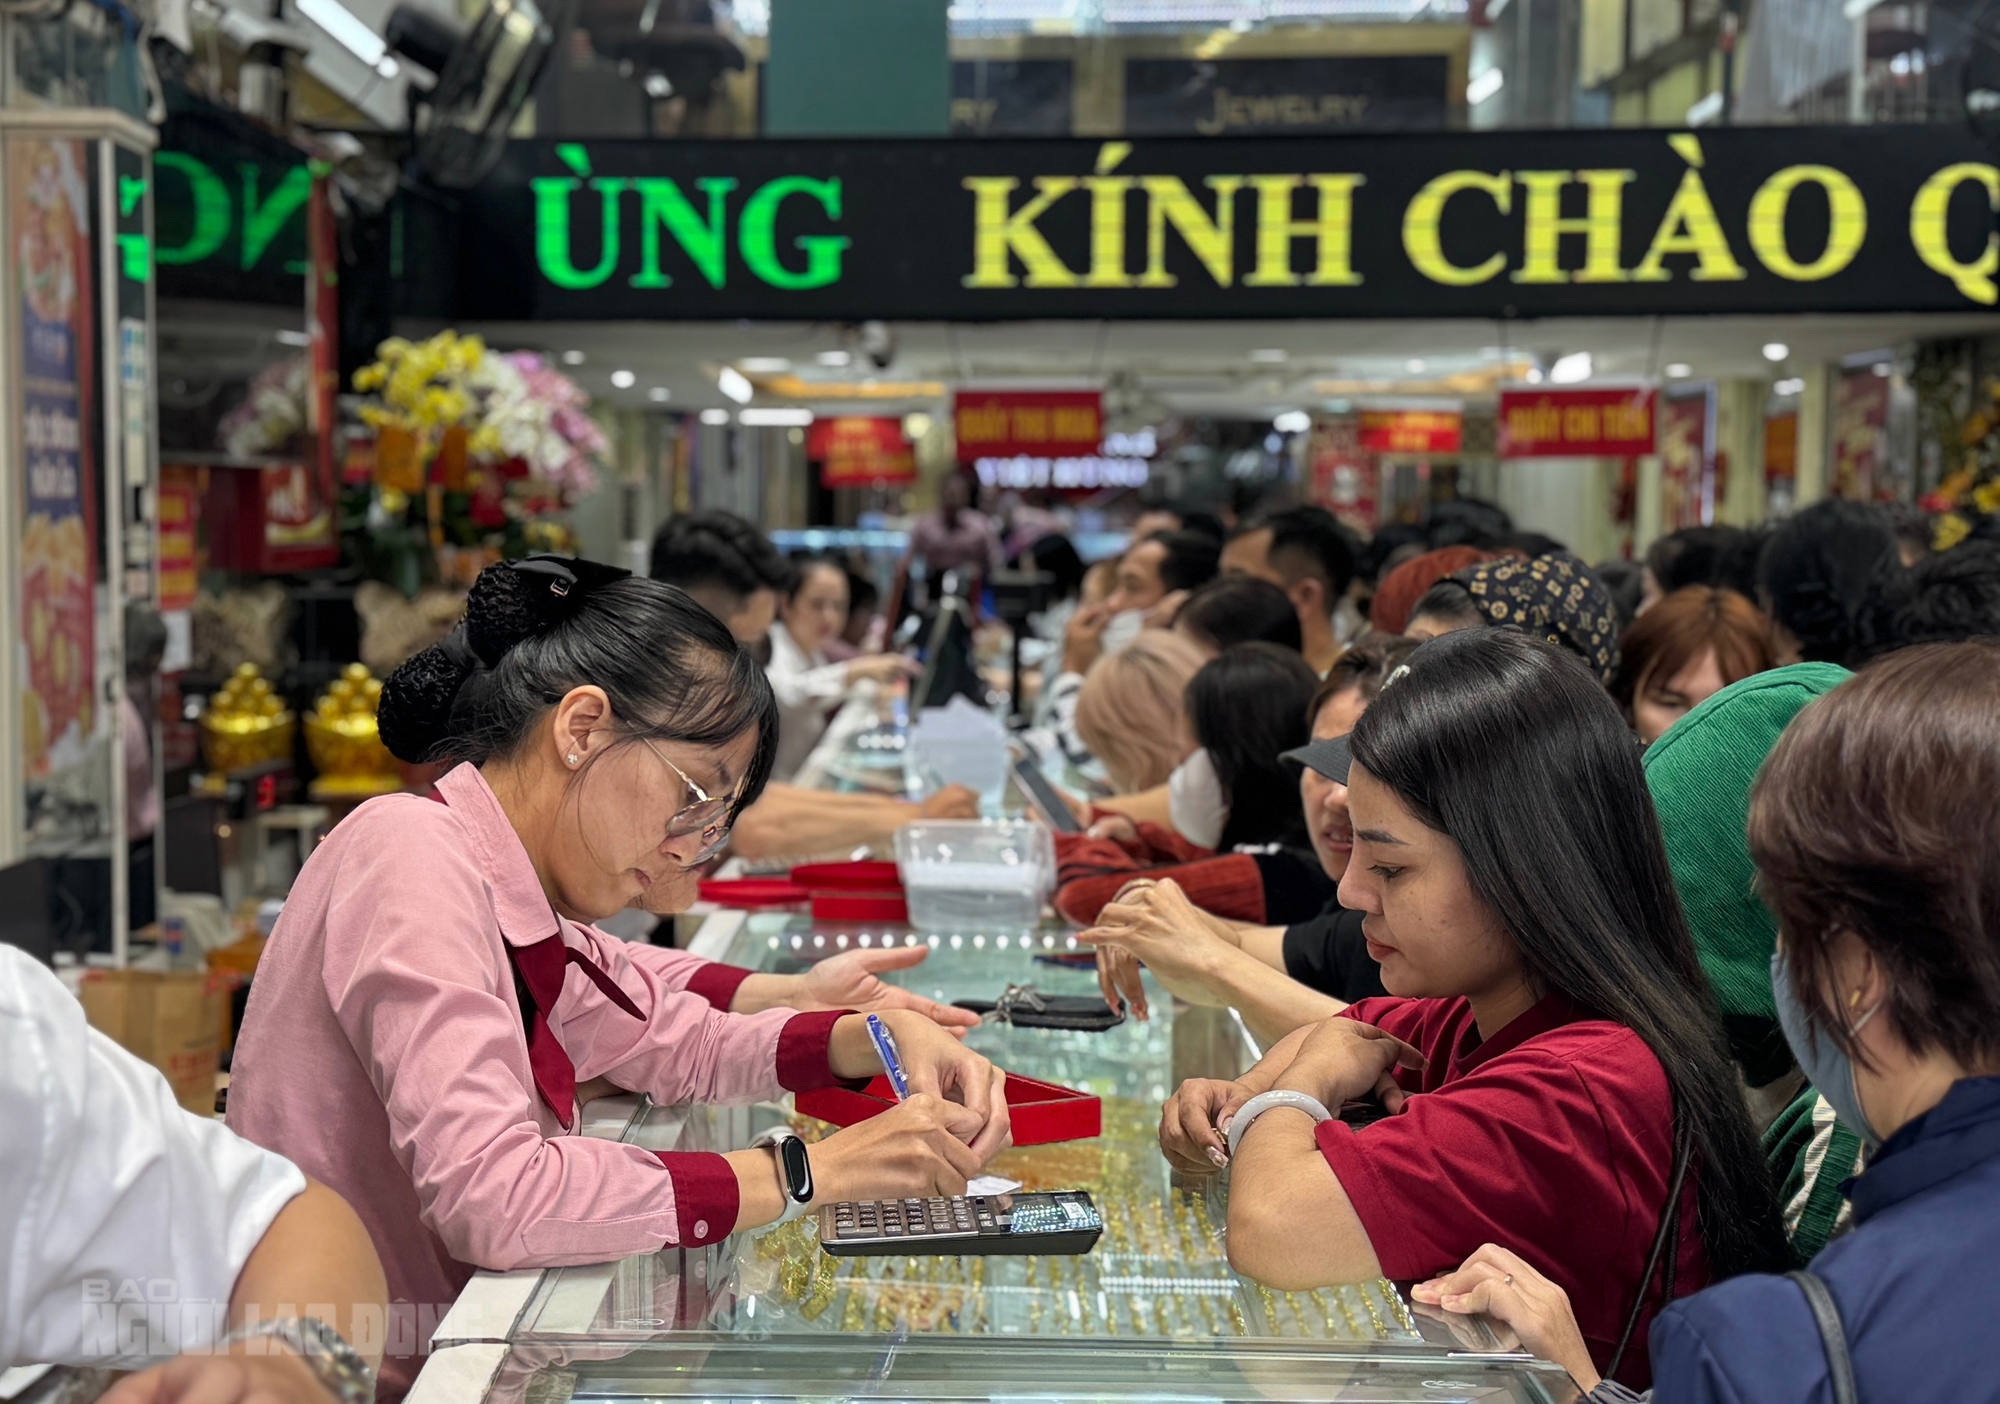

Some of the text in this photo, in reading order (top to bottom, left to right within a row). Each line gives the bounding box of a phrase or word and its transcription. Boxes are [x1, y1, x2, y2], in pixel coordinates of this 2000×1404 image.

[532, 143, 849, 289] ÙNG
[962, 142, 1364, 287] KÍNH
[1402, 134, 1867, 286] CHÀO
